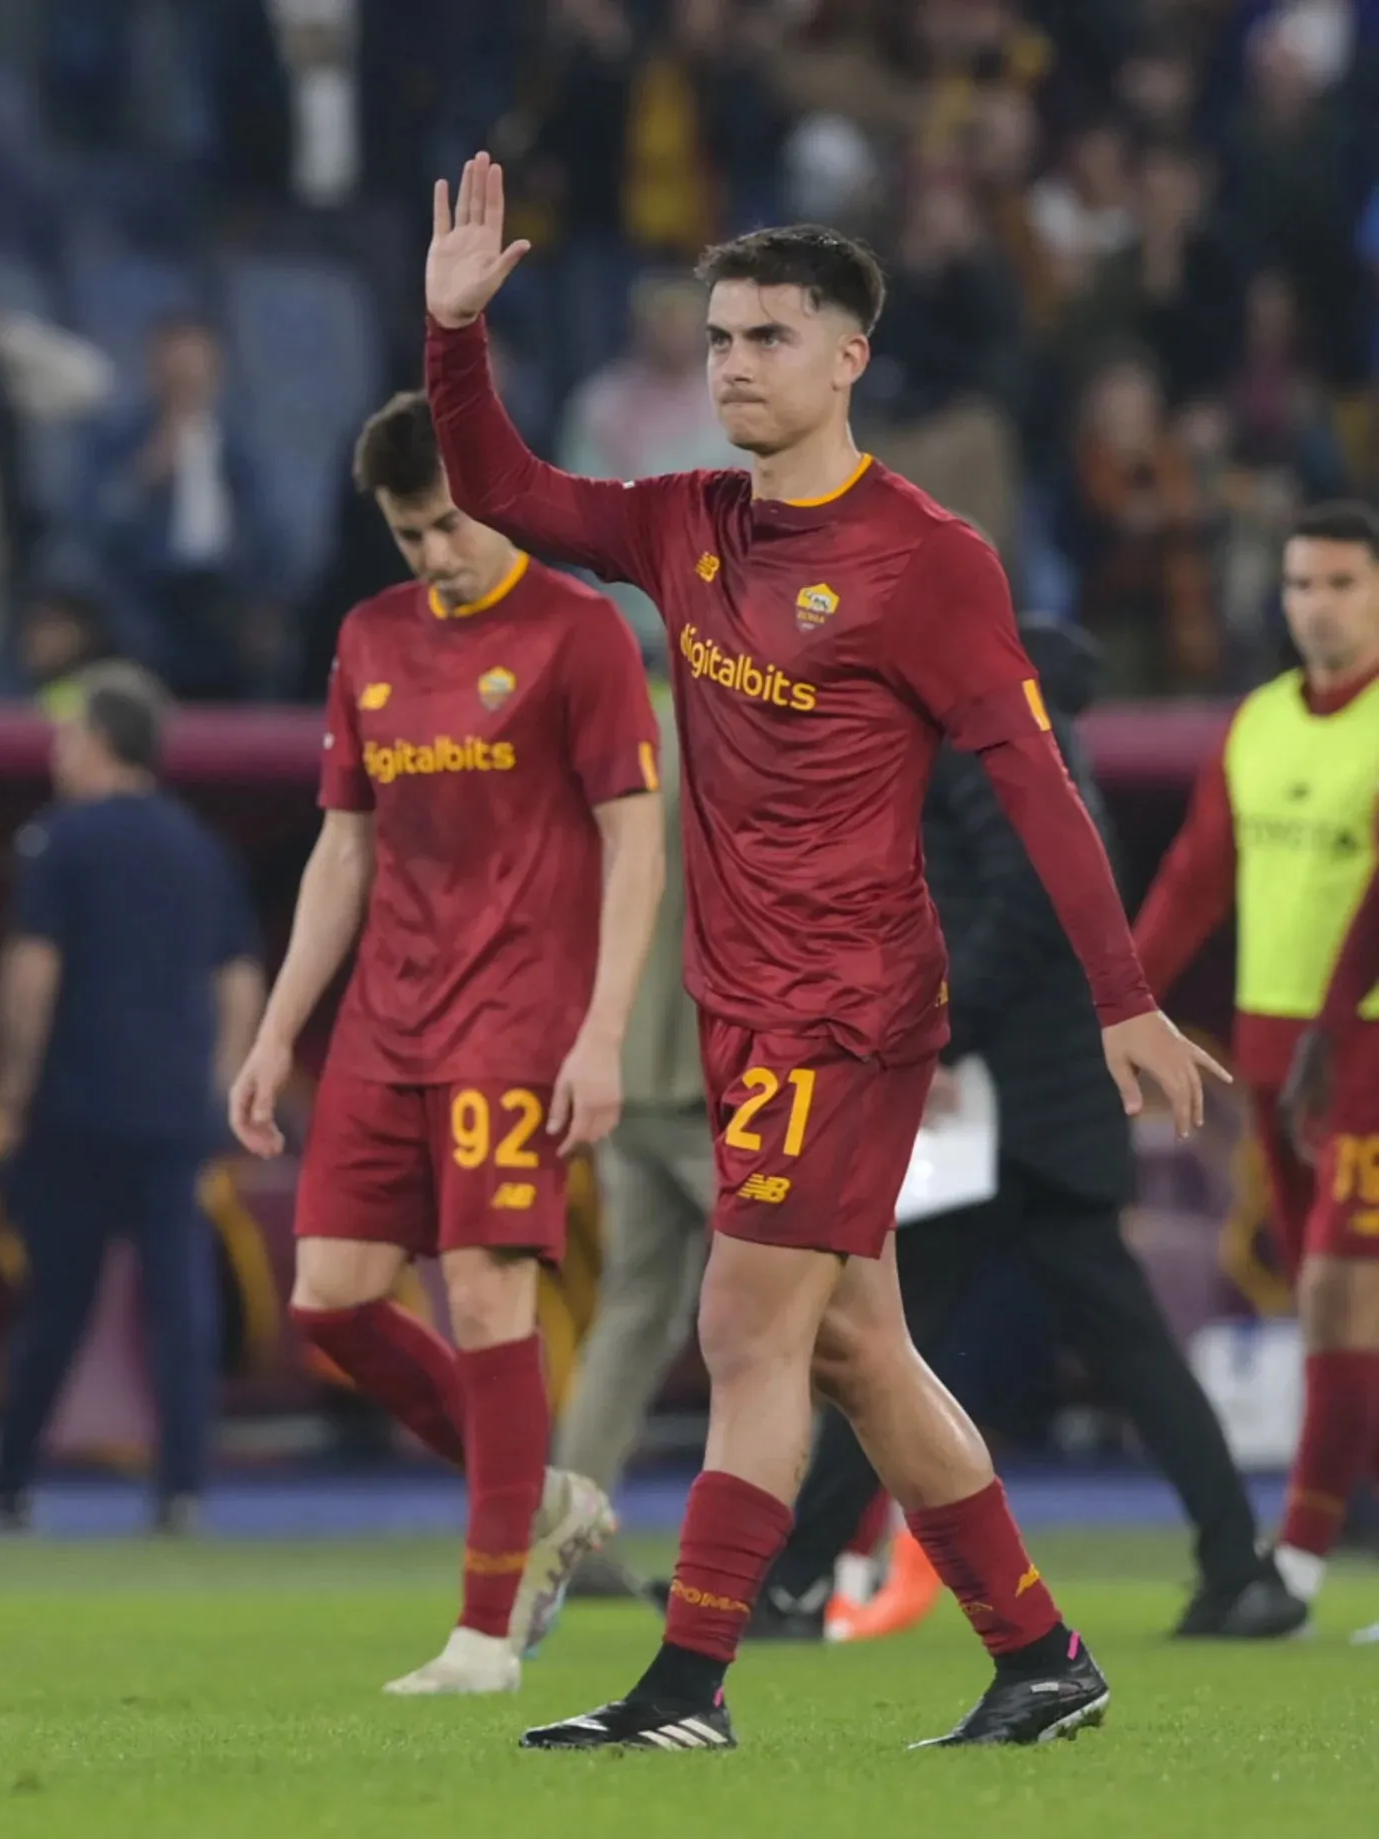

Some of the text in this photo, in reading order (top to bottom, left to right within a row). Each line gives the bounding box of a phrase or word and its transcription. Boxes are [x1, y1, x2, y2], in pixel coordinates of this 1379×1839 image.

[680, 622, 817, 712] digitalbits
[452, 1088, 541, 1169] 92
[725, 1067, 816, 1157] 21
